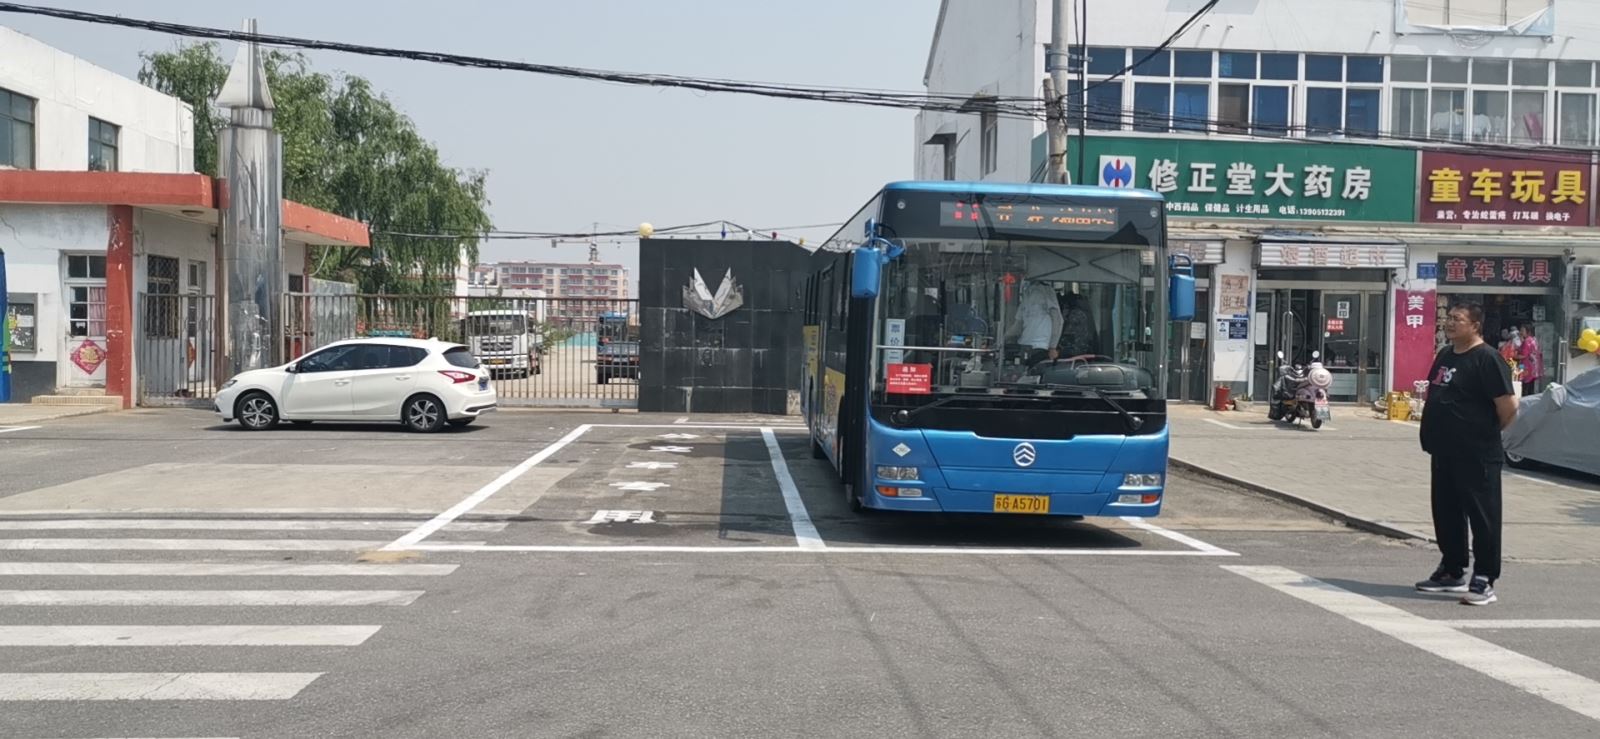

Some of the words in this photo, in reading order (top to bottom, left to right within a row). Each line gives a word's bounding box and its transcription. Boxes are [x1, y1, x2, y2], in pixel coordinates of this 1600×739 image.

[1148, 158, 1372, 200] 修正堂大药房
[1428, 167, 1586, 205] 童车玩具
[1165, 202, 1199, 212] 中西药品
[1204, 203, 1230, 213] 保健品
[1236, 203, 1269, 214] 计生用品
[1445, 257, 1552, 284] 童车玩具
[1406, 295, 1425, 329] 美甲
